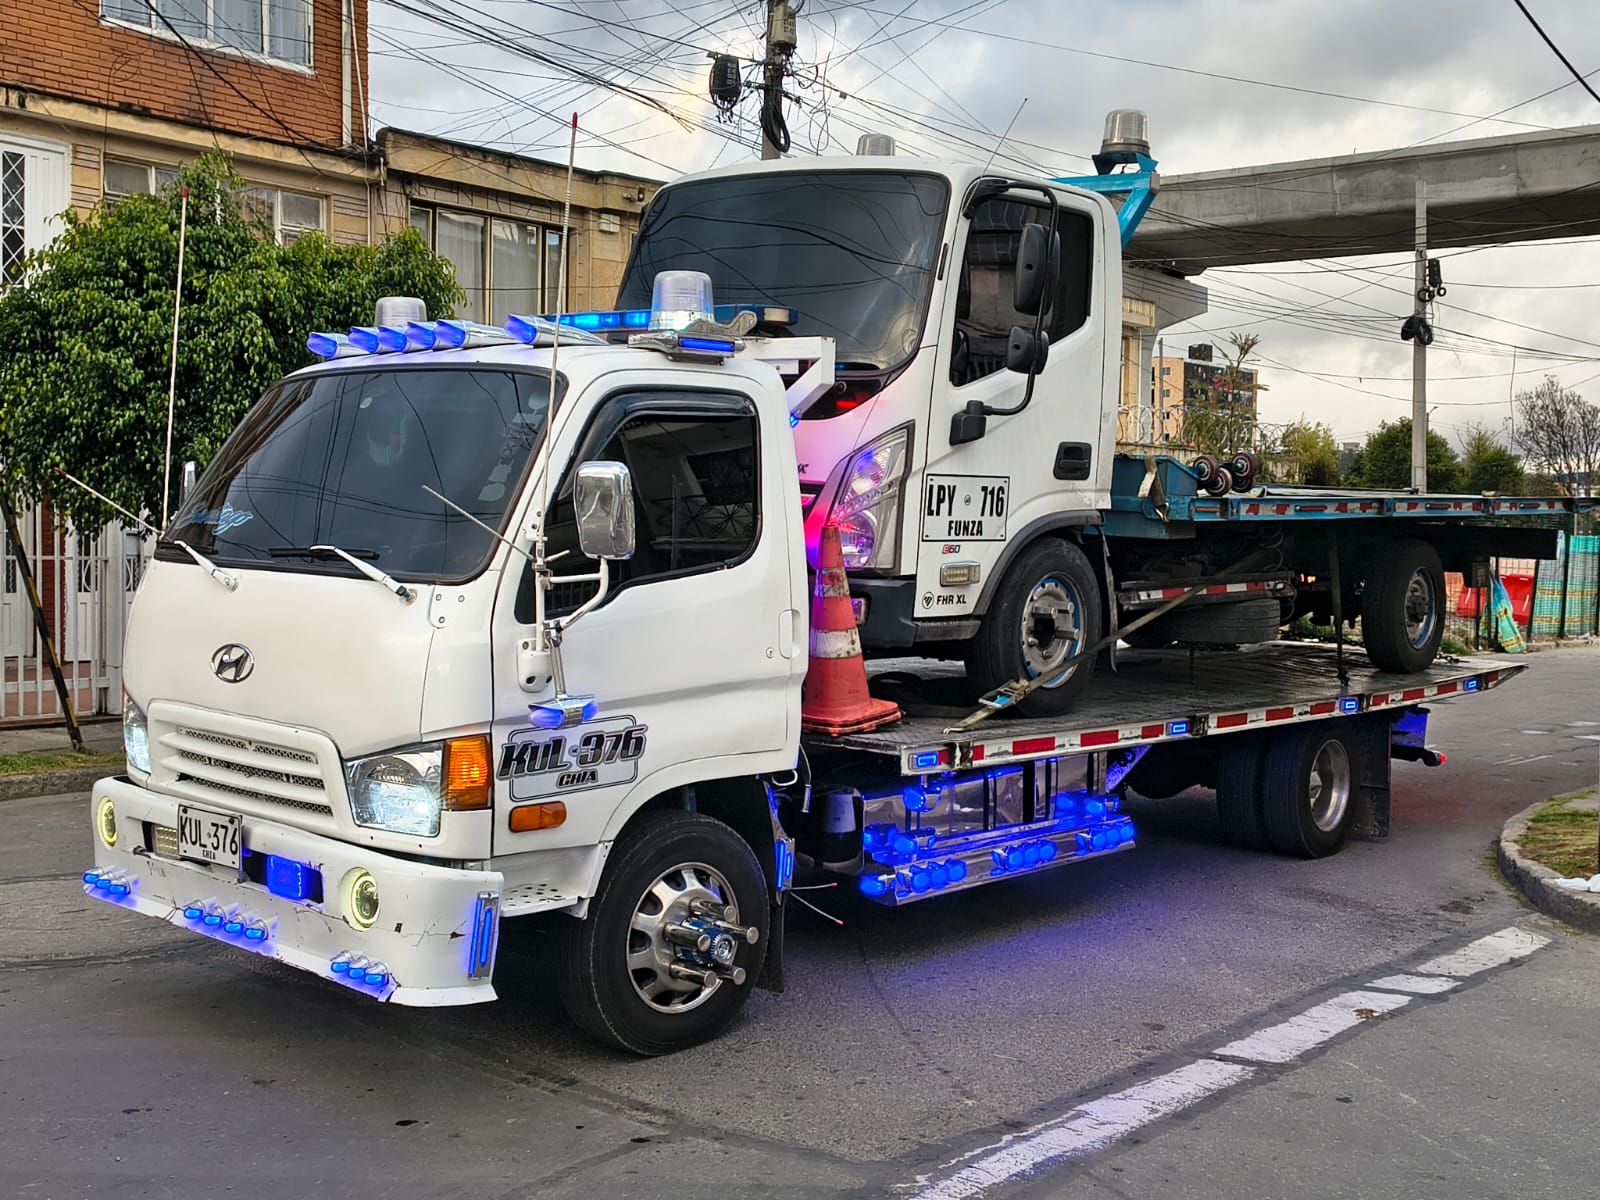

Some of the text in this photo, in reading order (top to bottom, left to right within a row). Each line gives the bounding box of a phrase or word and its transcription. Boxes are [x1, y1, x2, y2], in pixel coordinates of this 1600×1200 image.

[927, 484, 1005, 517] LPY 716
[947, 520, 983, 537] FUNZA
[941, 544, 960, 555] E60
[936, 594, 967, 605] FHR XL
[498, 725, 647, 779] KUL 376
[557, 769, 598, 788] CHIA
[180, 815, 238, 855] KUL 376
